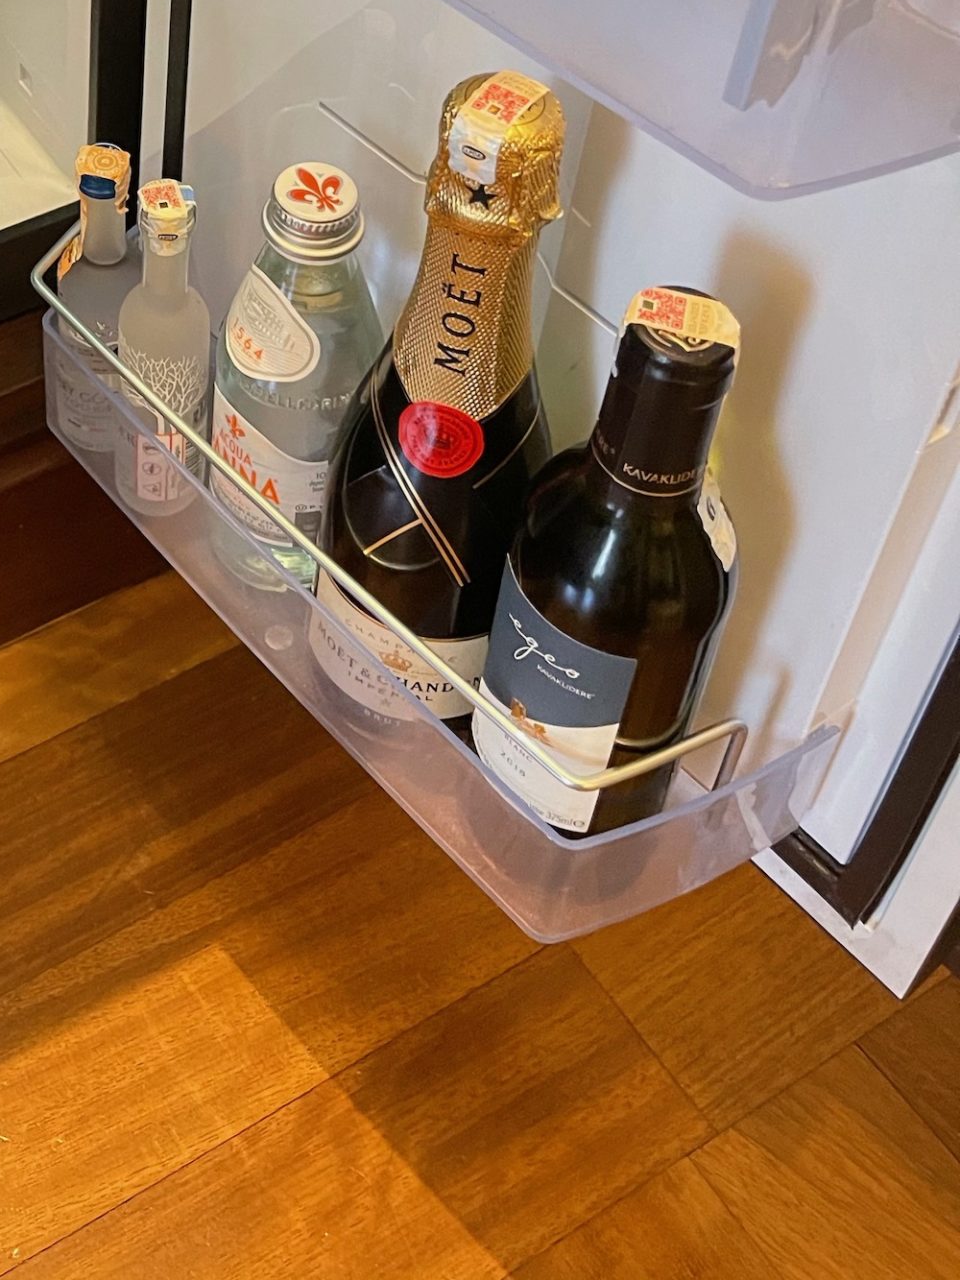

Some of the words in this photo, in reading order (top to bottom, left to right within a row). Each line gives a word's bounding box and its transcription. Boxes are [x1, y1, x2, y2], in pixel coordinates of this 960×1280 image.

[433, 252, 488, 378] MOËT
[219, 428, 253, 467] ACQUA
[536, 663, 592, 700] KAVAKLIDERE
